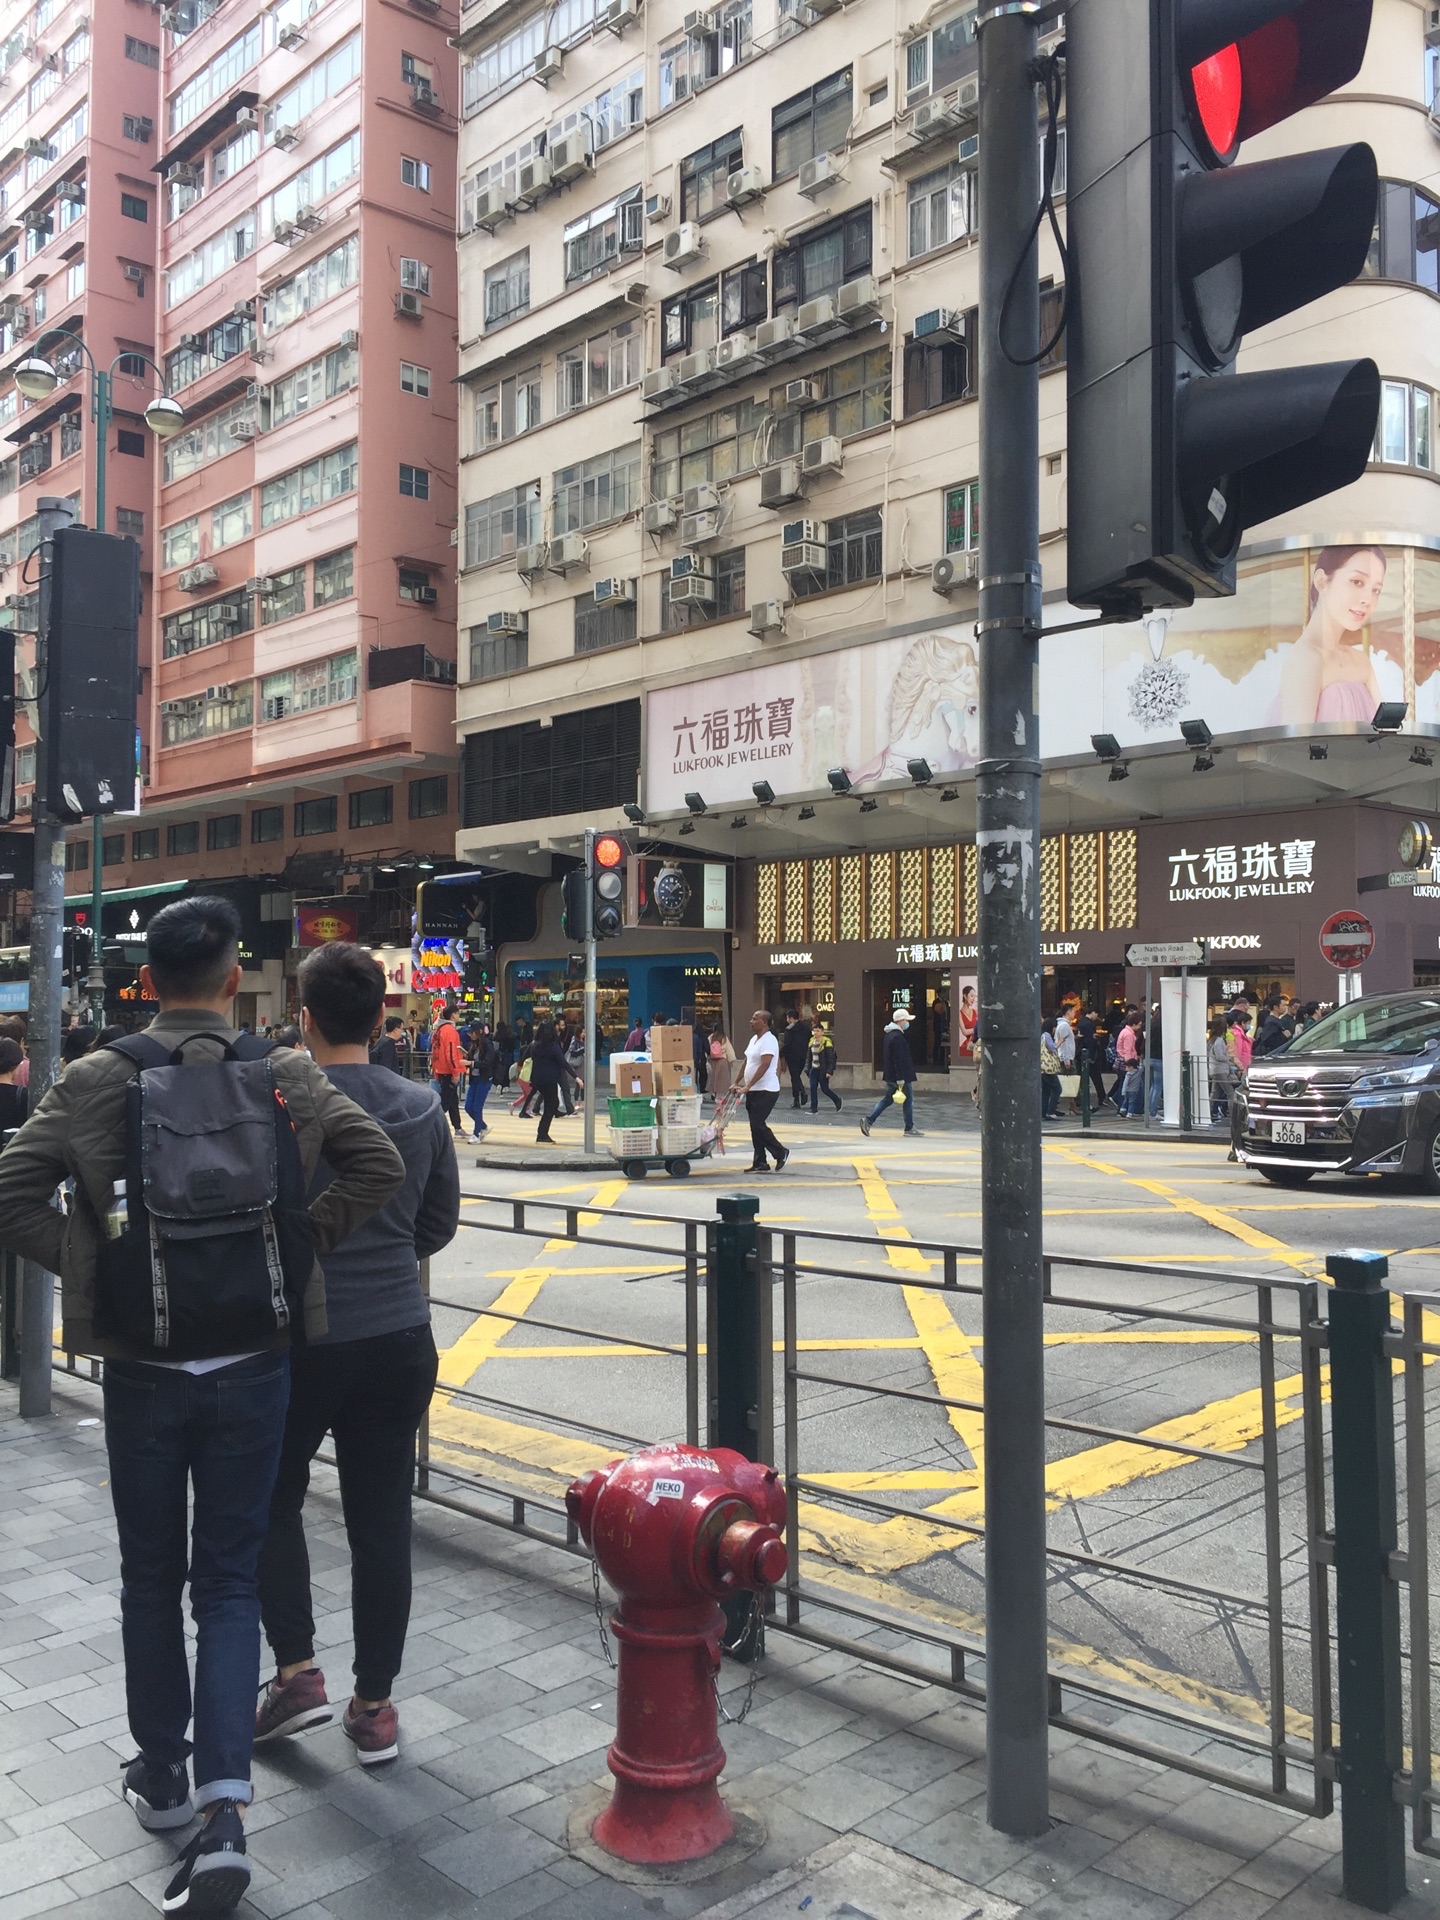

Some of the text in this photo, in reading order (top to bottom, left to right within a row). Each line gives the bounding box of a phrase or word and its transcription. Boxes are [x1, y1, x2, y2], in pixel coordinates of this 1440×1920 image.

[673, 697, 795, 758] 六福珠寶
[673, 742, 794, 775] LUKFOOK JEWELLERY
[1168, 838, 1316, 887] 六福珠寶
[1169, 880, 1315, 901] LUKFOOK JEWELLERY
[1192, 935, 1262, 950] KFOOK
[420, 950, 452, 967] Nikon
[770, 952, 813, 965] LUKFOOK
[896, 943, 954, 964] 六福珠寶
[411, 969, 461, 990] Canon
[684, 967, 722, 976] HANNA
[1281, 1122, 1296, 1133] KZ
[1275, 1131, 1302, 1144] 3008
[655, 1481, 681, 1493] NEKO
